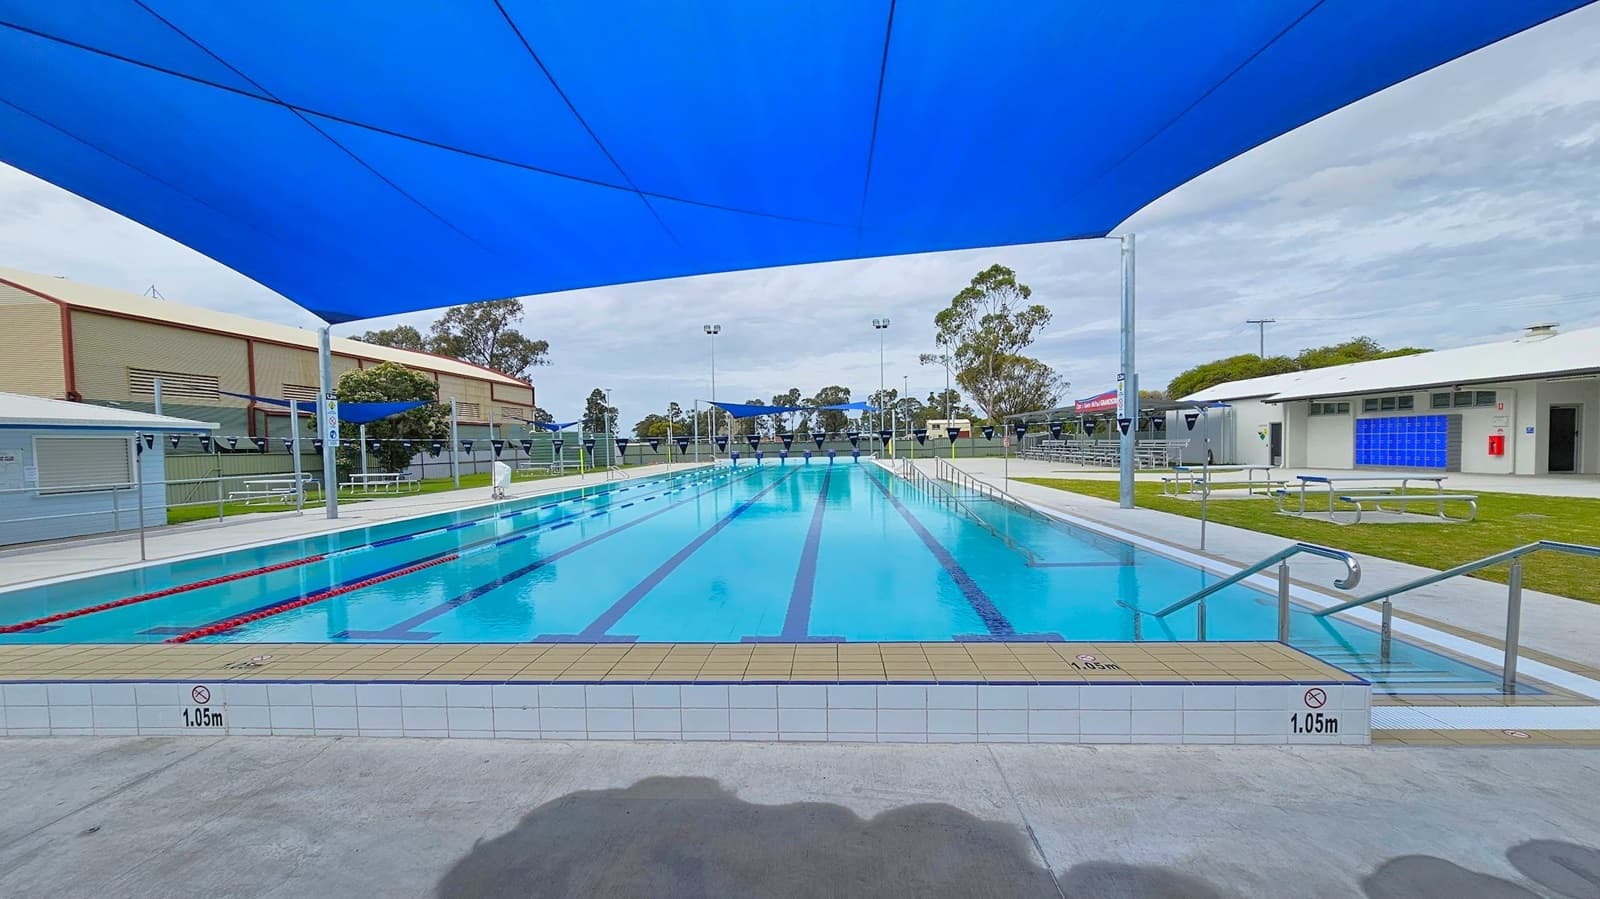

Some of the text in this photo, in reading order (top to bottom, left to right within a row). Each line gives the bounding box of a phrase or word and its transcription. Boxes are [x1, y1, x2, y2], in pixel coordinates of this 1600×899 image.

[1071, 661, 1121, 670] 1.05m
[182, 707, 223, 727] 1.05m
[1290, 712, 1338, 734] 1.05m
